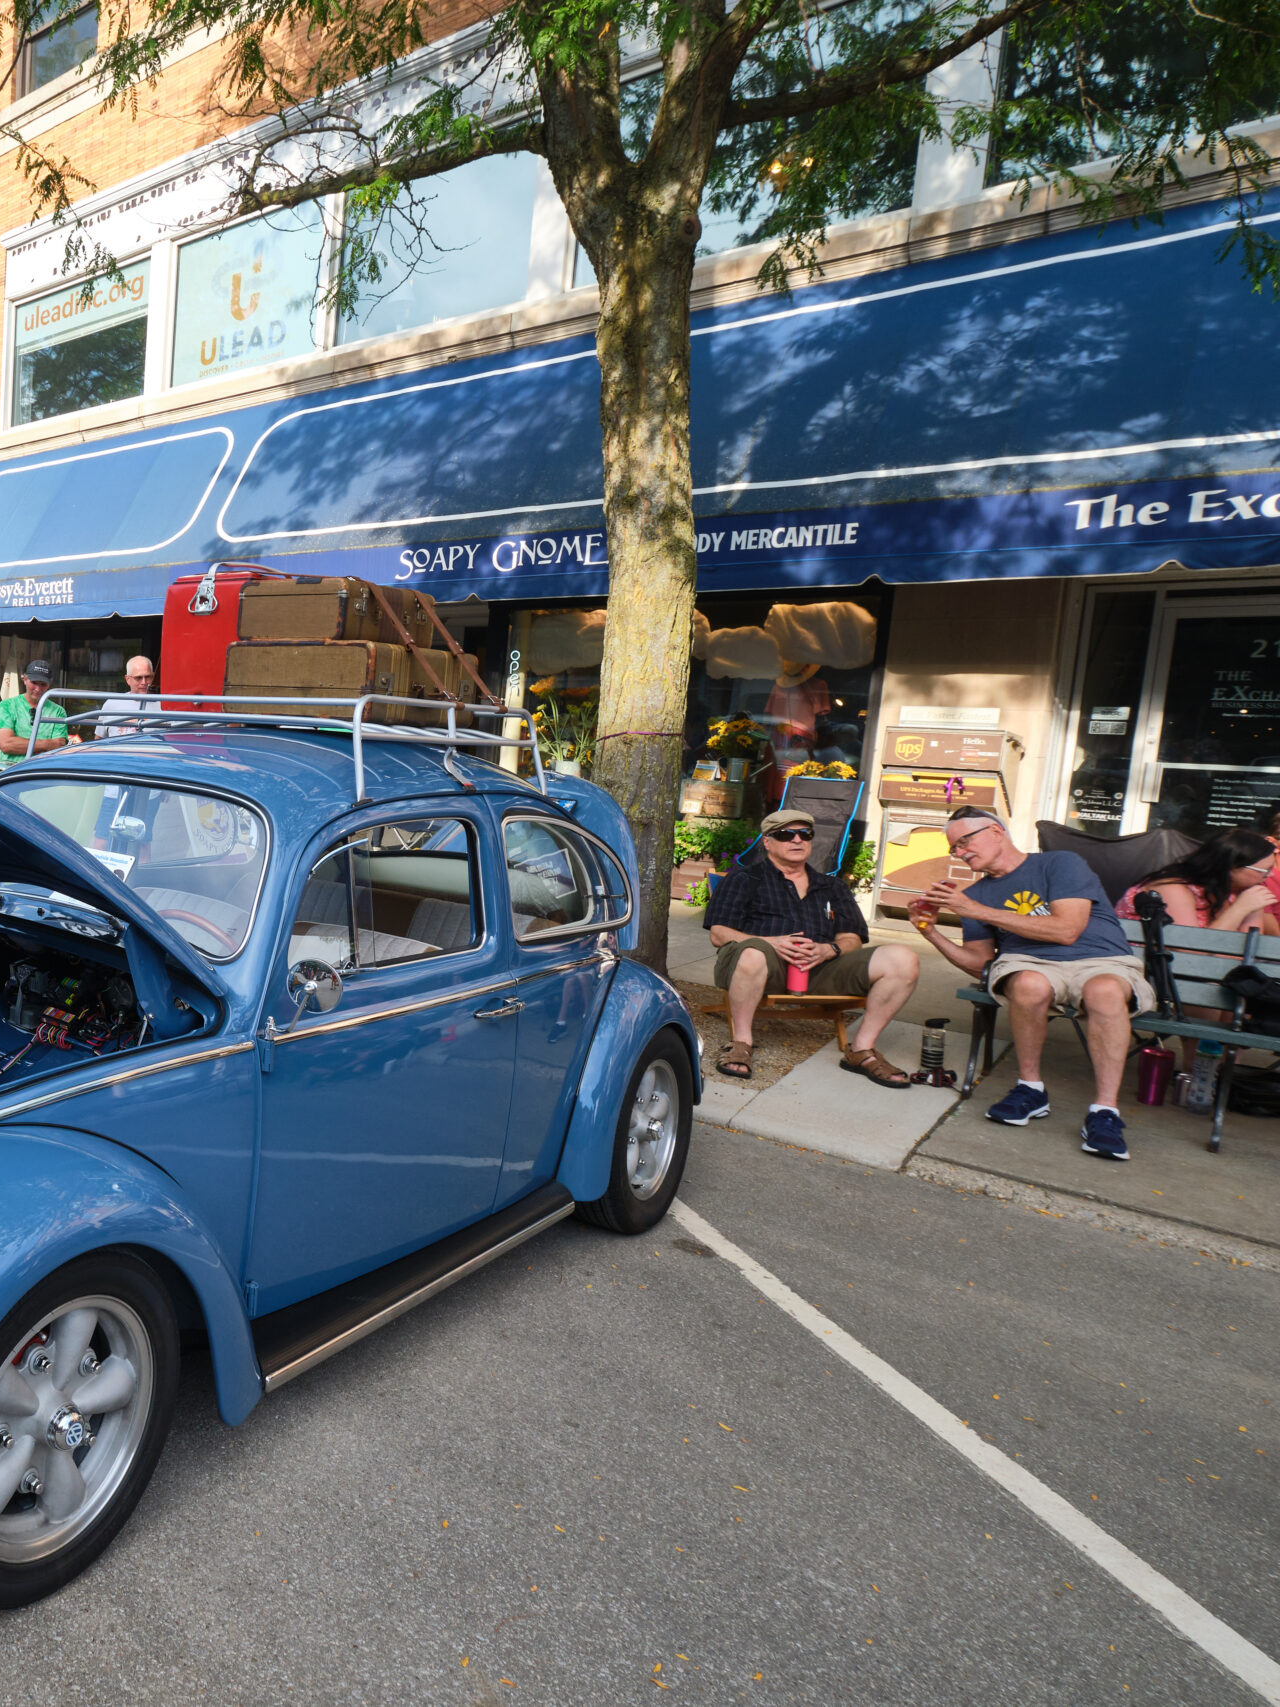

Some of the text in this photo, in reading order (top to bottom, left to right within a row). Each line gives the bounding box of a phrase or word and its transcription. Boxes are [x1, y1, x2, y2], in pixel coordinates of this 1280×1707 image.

[24, 275, 144, 331] uleadinc.org
[200, 320, 286, 365] ULEAD
[1064, 494, 1170, 530] The
[395, 544, 481, 580] SOAPY
[492, 533, 609, 572] GNOME
[730, 522, 859, 551] MERCANTILE
[12, 594, 74, 607] REAL ESTATE
[1216, 671, 1253, 681] THE
[1210, 685, 1280, 701] EXCH
[898, 743, 921, 758] ups
